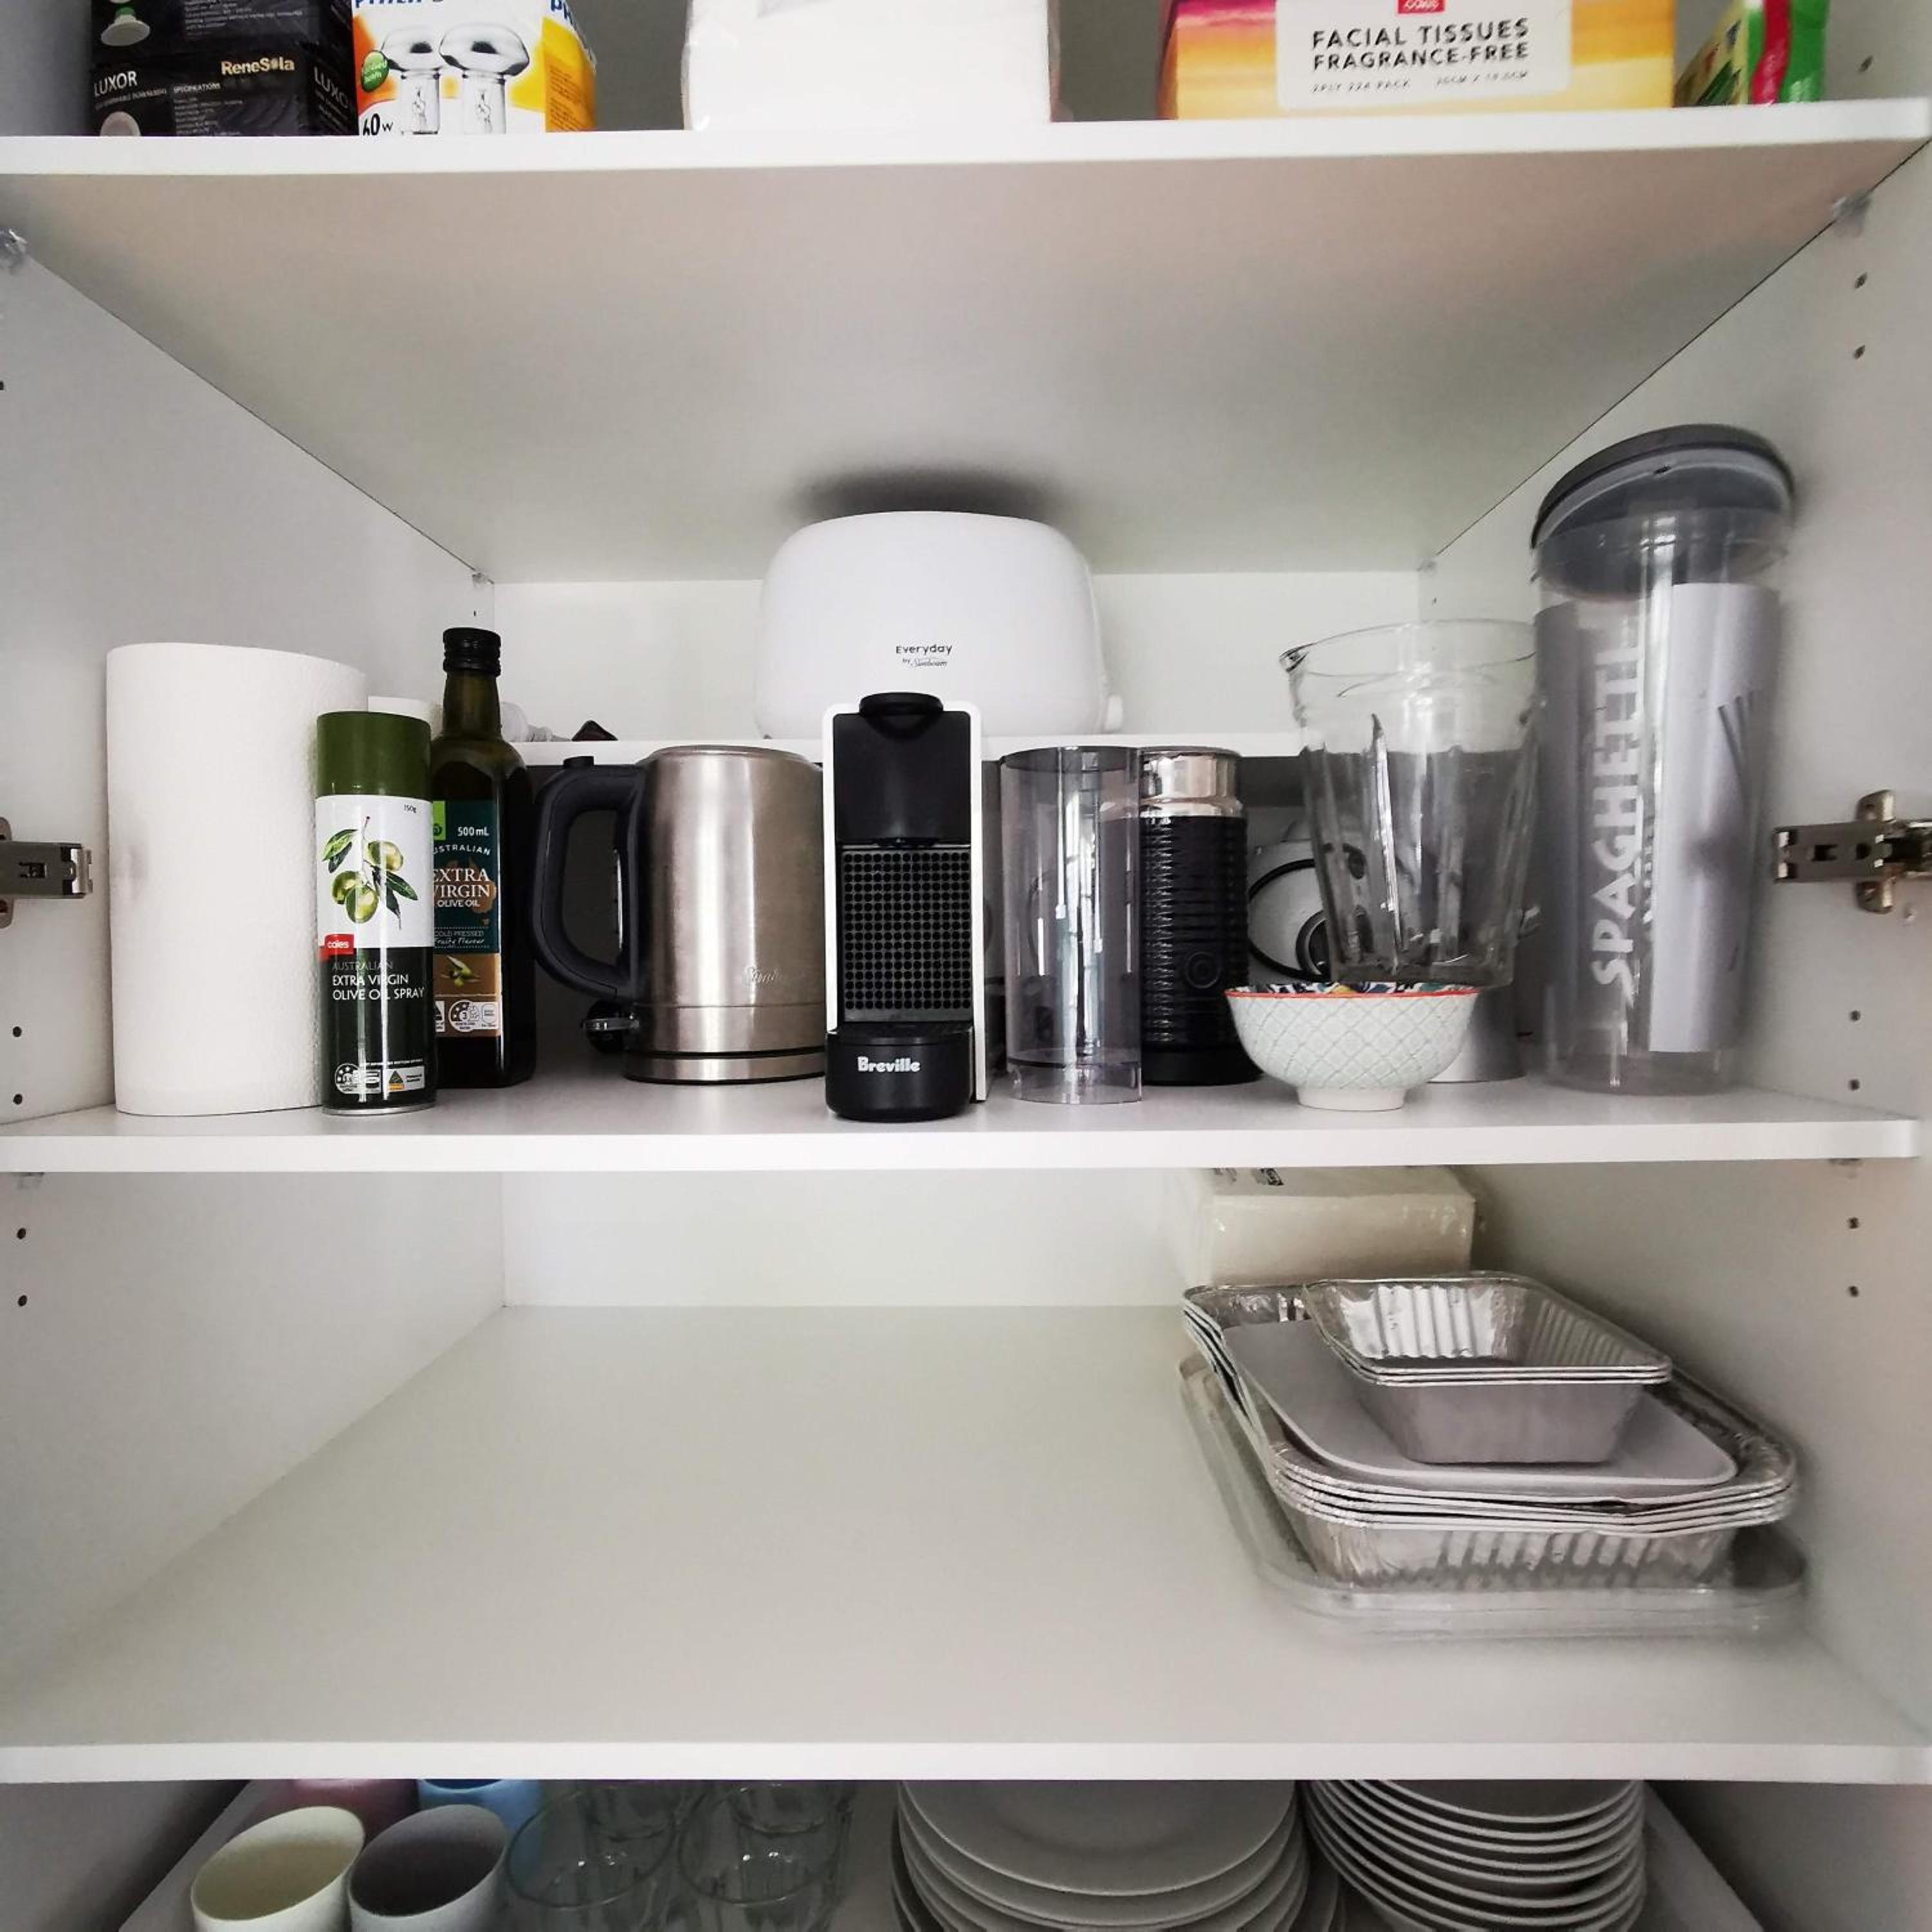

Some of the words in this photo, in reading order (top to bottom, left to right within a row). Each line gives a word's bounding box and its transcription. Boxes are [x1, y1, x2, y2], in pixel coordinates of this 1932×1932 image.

[1312, 27, 1408, 50] FACIAL
[1419, 18, 1529, 45] TISSUES
[1312, 42, 1529, 71] FRAGRANCE-FREE
[93, 70, 138, 97] LUXOR
[314, 66, 350, 109] LUXO
[896, 644, 952, 656] Everyday
[1592, 646, 1642, 1009] SPAGHETTI
[433, 844, 491, 857] USTRALIAN
[438, 900, 464, 908] OLIVE
[464, 899, 481, 907] OIL
[327, 940, 350, 949] coles
[332, 974, 366, 987] EXTRA
[332, 989, 366, 1000] OLIVE
[393, 986, 425, 999] SPRAY
[857, 1056, 921, 1072] Breville
